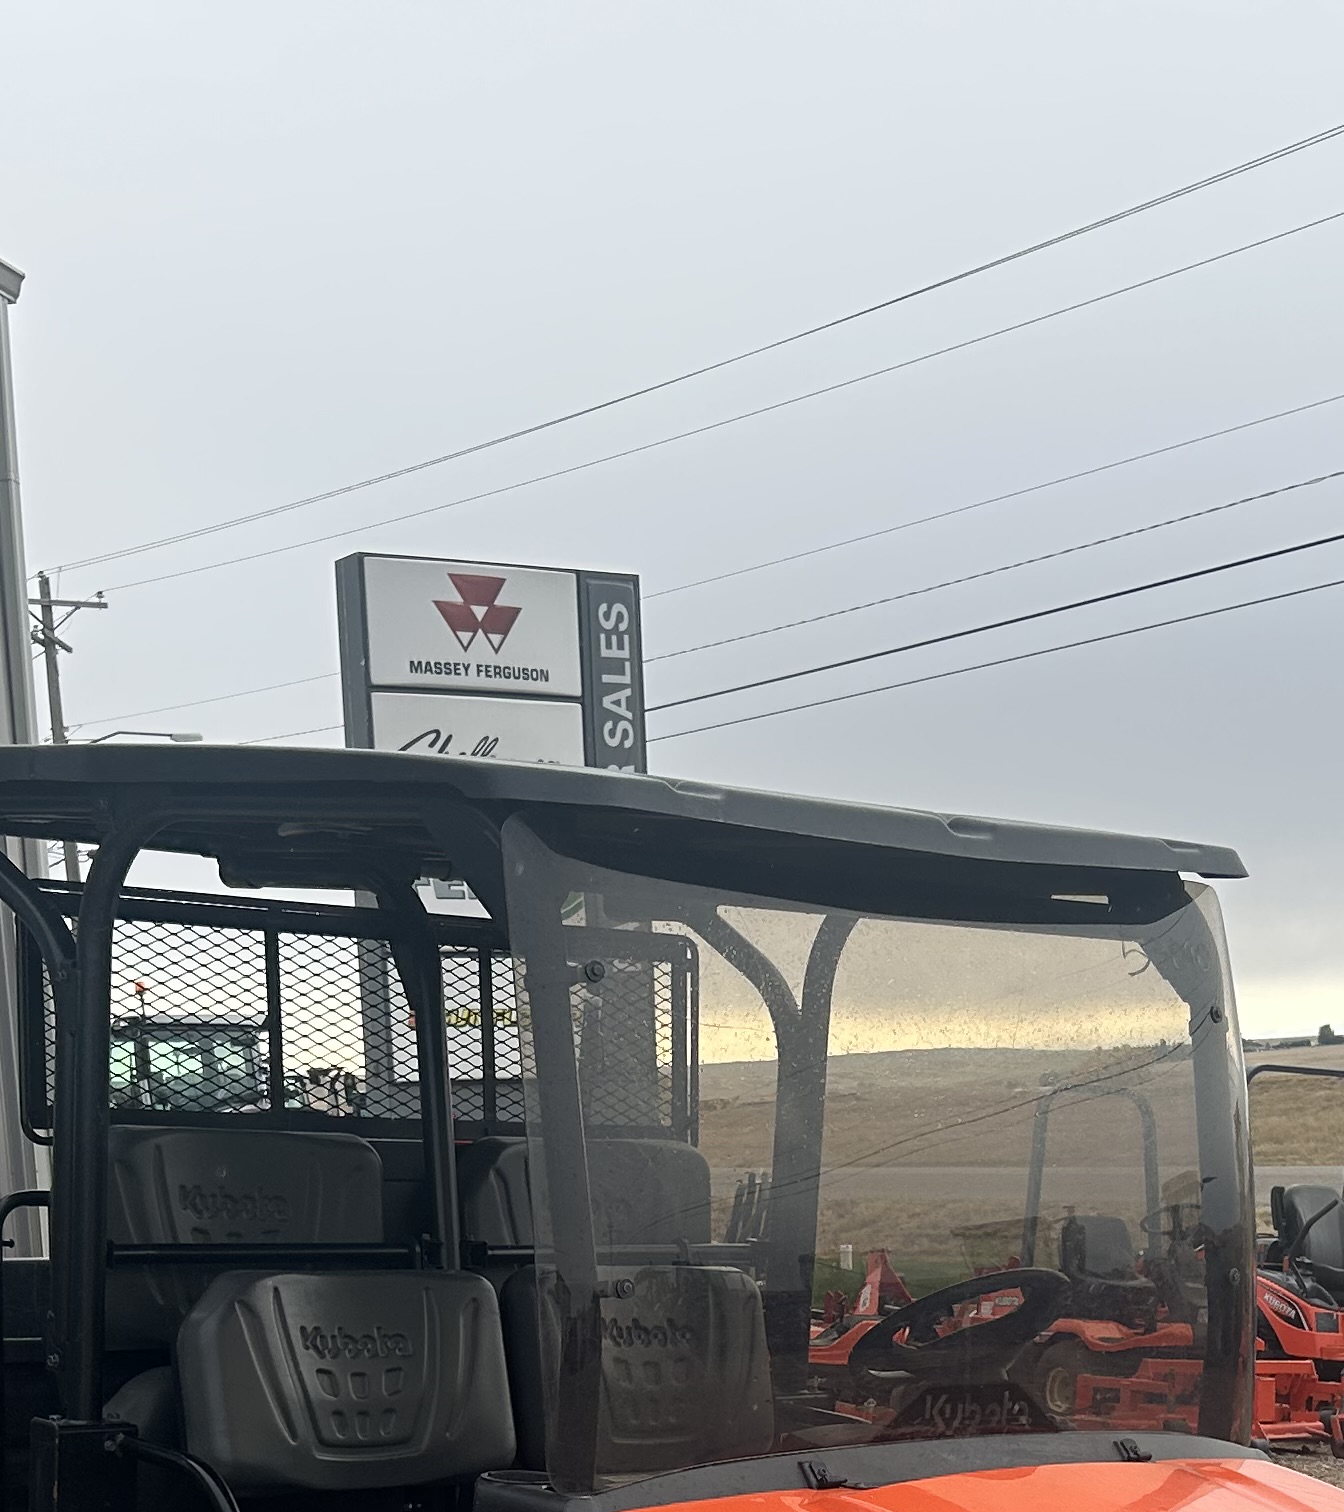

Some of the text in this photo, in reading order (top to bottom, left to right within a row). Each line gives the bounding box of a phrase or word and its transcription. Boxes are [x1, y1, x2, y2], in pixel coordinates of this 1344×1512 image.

[410, 660, 550, 682] MASSEY FERGUSON
[599, 602, 635, 750] SALES
[178, 1183, 290, 1222] Kubota
[1263, 1291, 1296, 1320] KUBOTA
[299, 1324, 413, 1359] Kubota
[924, 1391, 1031, 1432] Kubota
